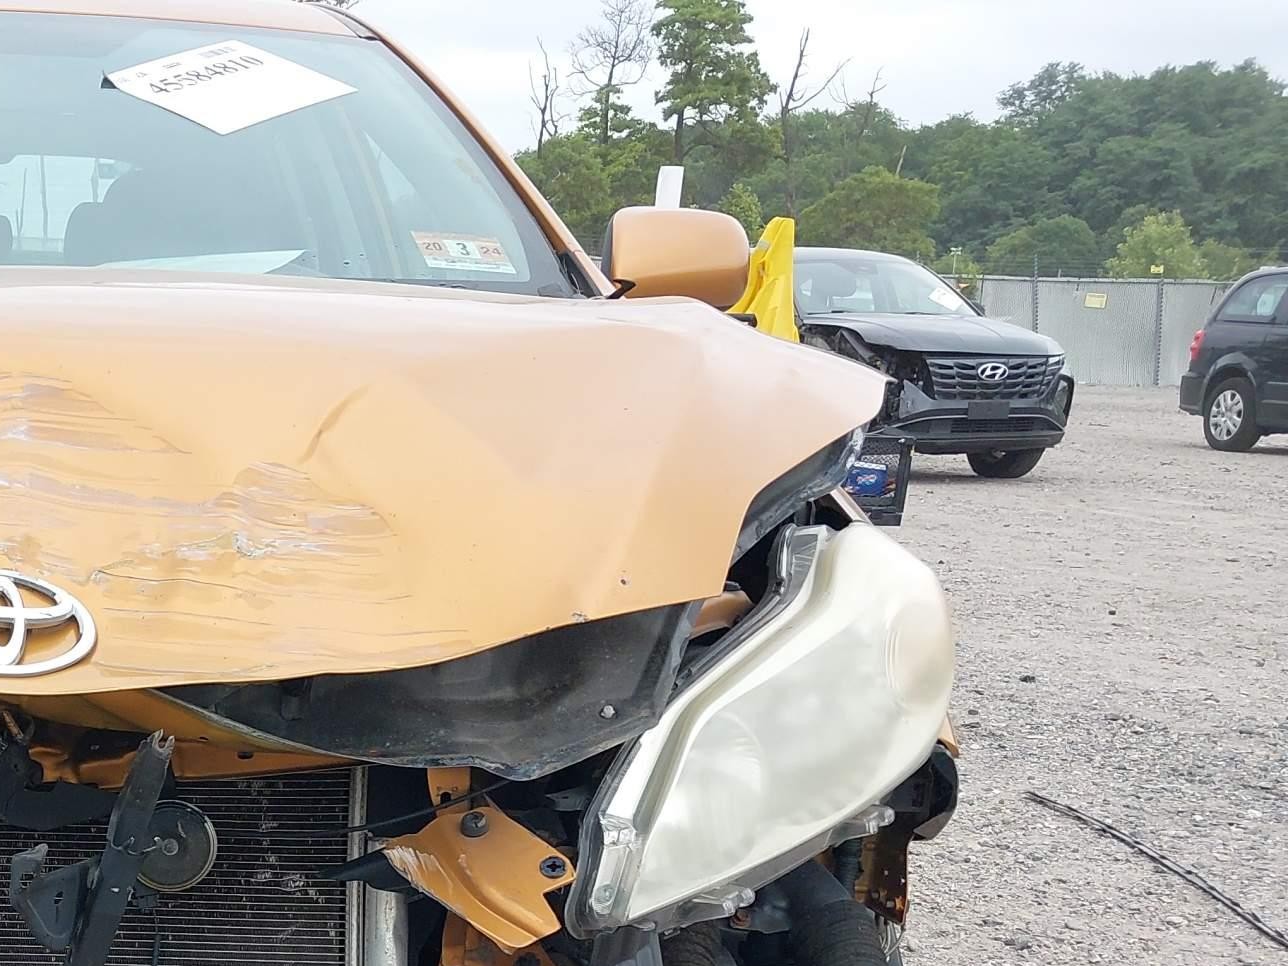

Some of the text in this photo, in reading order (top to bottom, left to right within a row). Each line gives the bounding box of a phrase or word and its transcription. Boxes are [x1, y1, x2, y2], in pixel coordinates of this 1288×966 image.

[149, 55, 264, 93] 45584810
[423, 242, 442, 251] 20
[456, 242, 470, 256] 3
